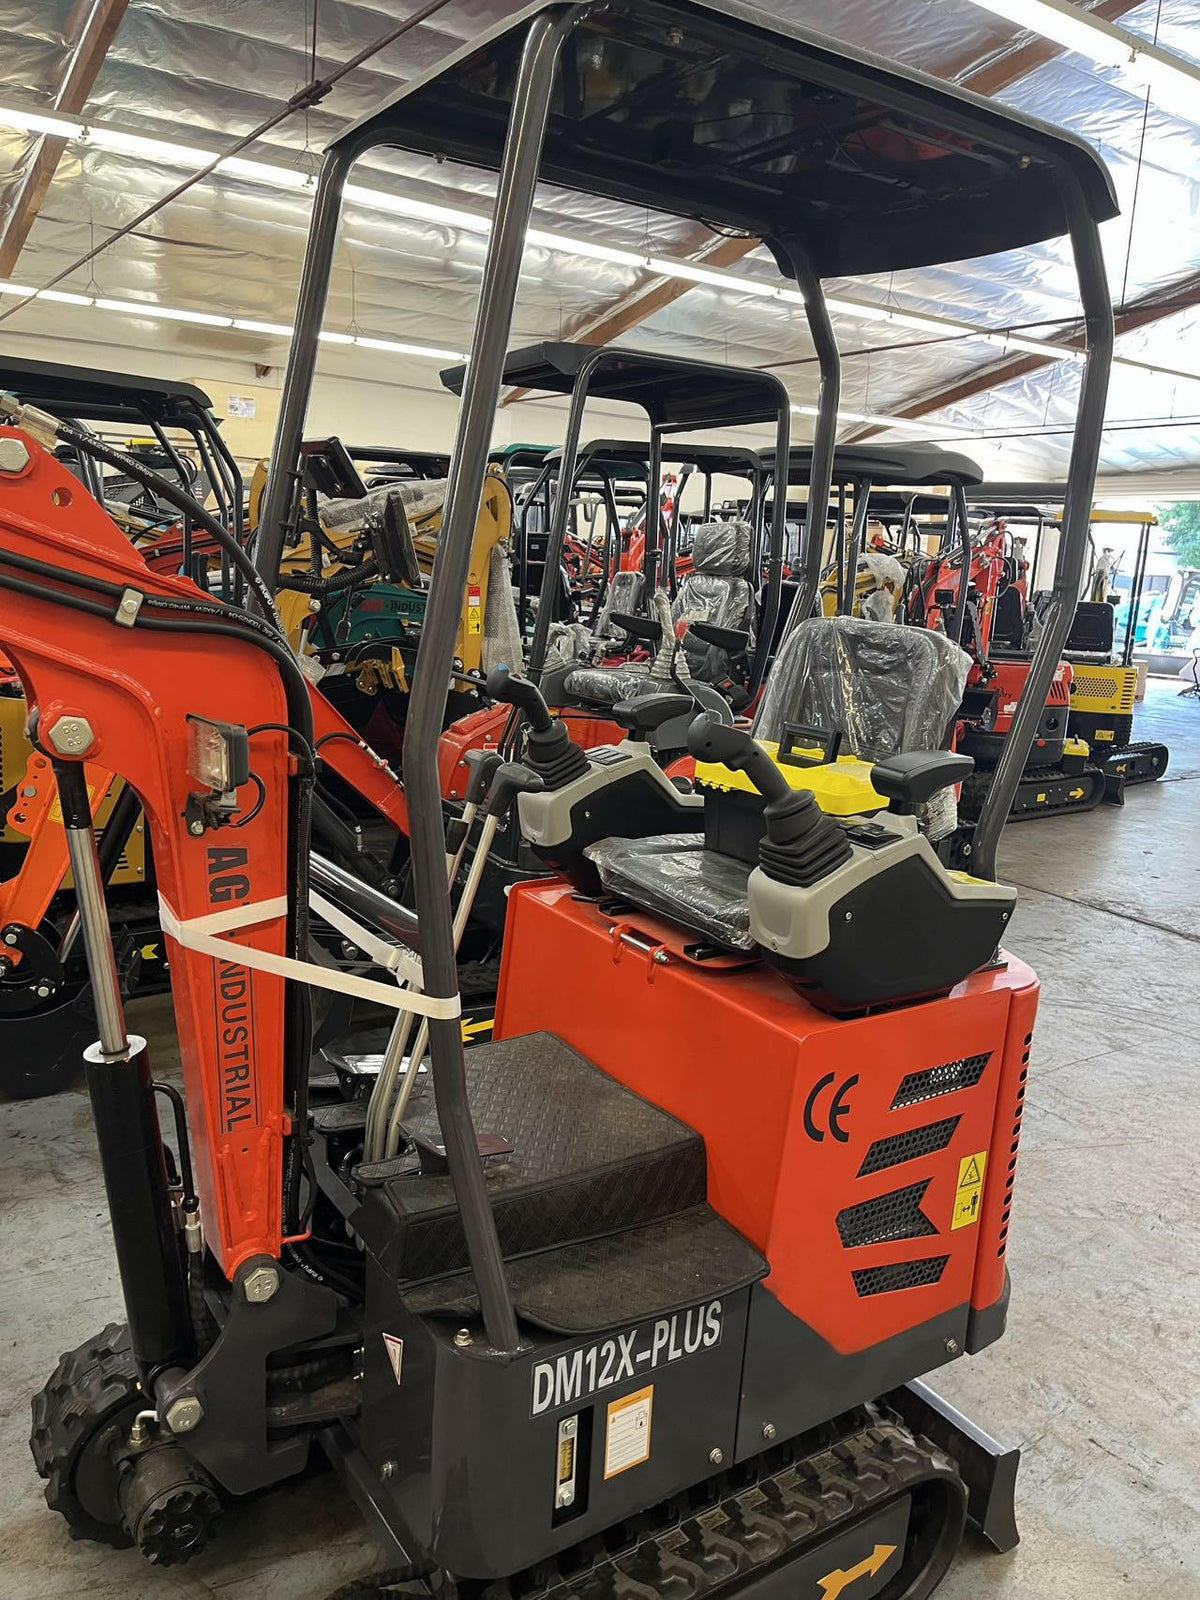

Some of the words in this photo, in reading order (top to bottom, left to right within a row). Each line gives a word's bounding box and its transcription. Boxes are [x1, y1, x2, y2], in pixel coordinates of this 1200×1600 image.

[207, 847, 251, 906] AG
[219, 959, 252, 1133] NDUSTRIAL
[803, 1071, 860, 1144] CE
[532, 1300, 722, 1415] DM12X-PLUS
